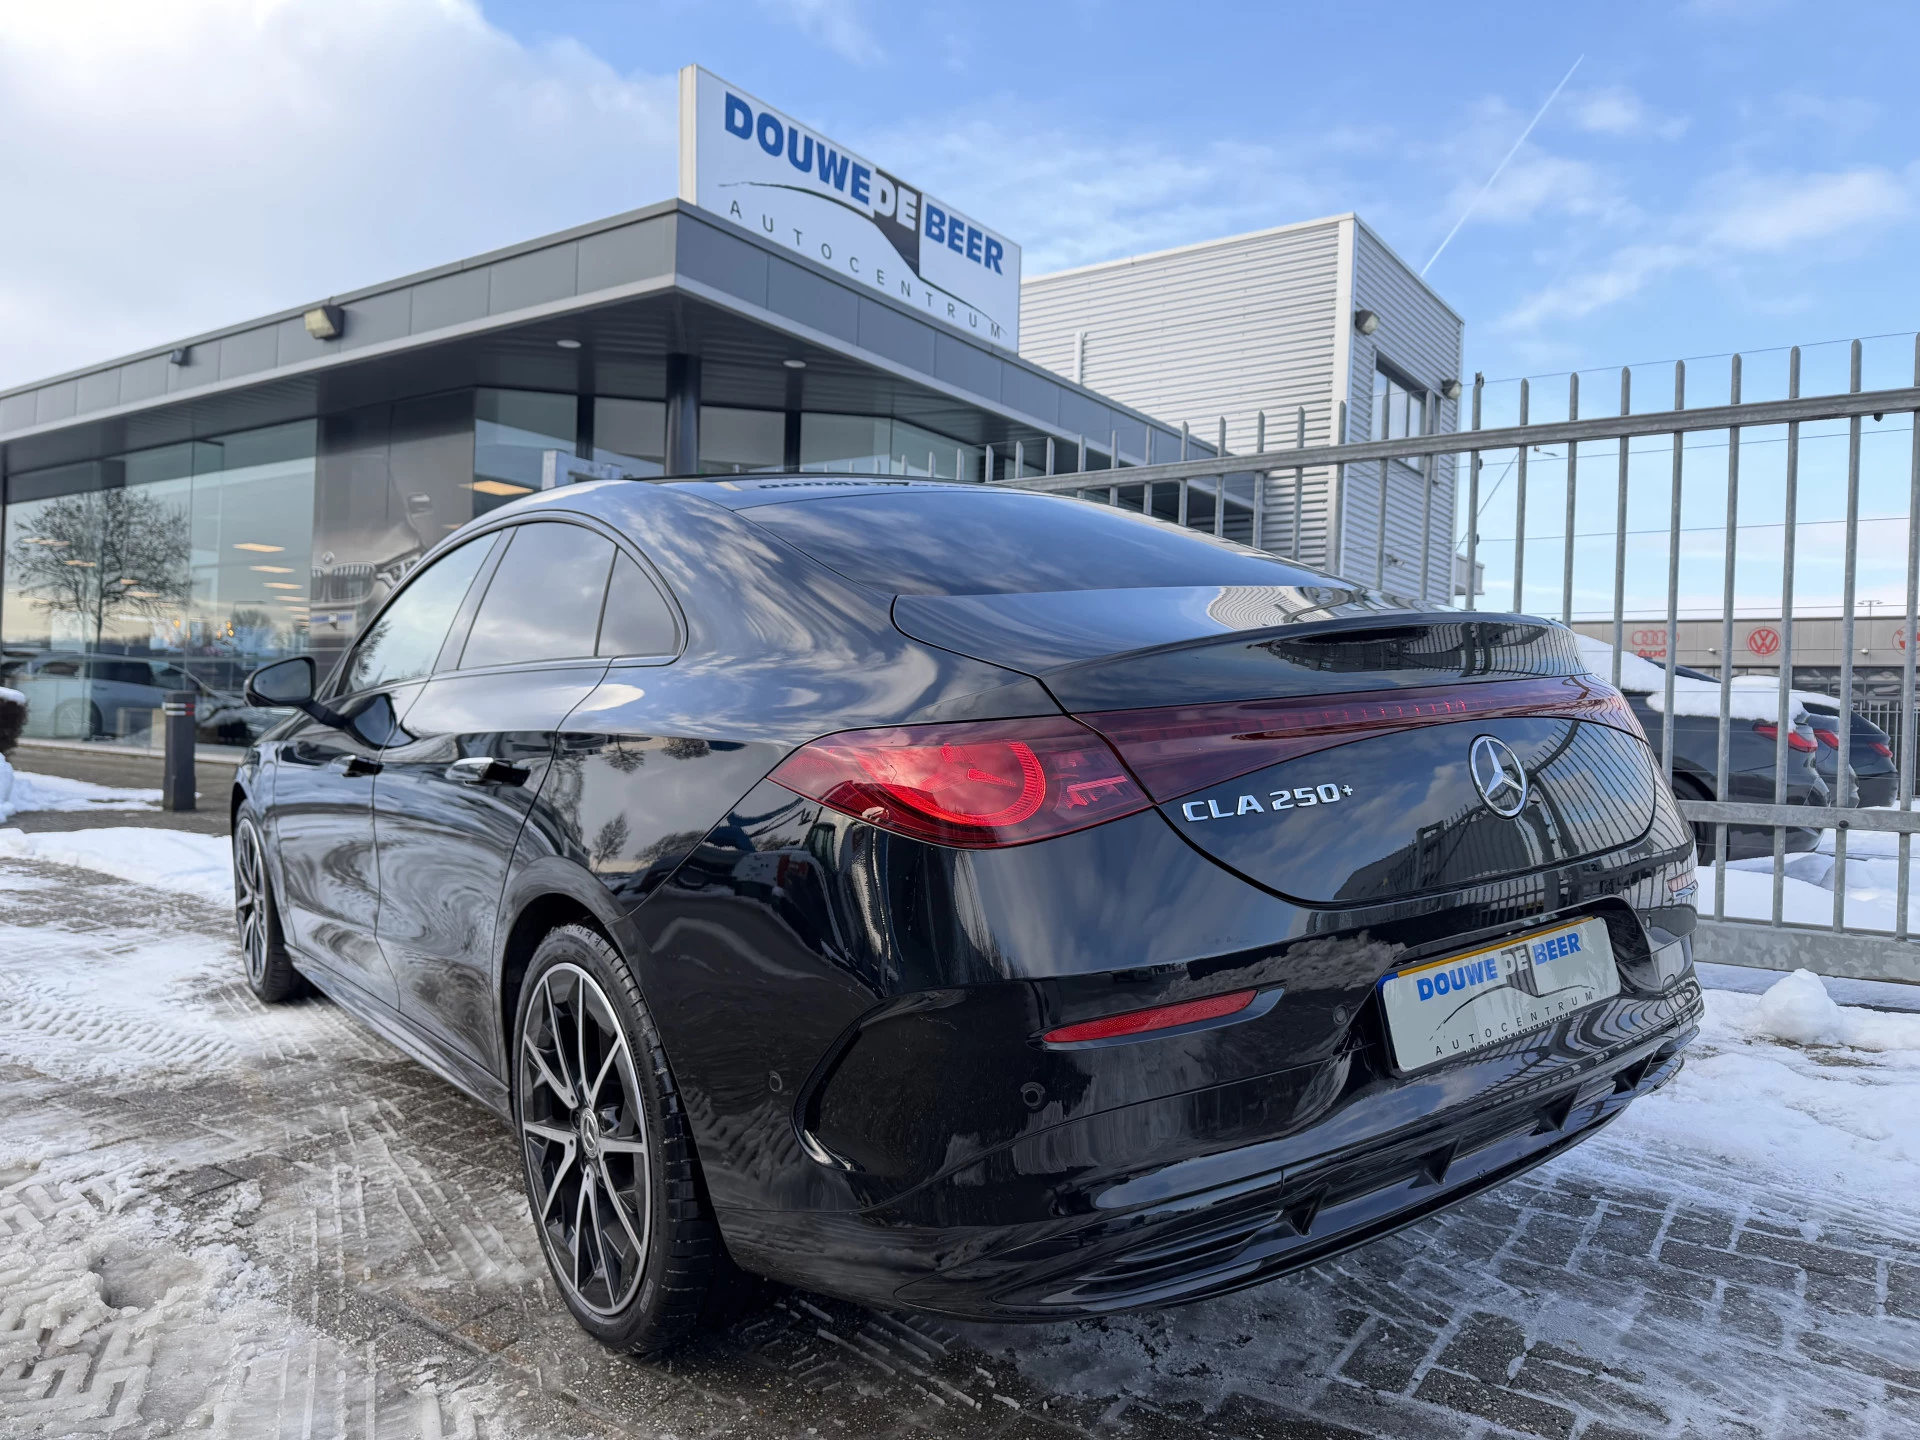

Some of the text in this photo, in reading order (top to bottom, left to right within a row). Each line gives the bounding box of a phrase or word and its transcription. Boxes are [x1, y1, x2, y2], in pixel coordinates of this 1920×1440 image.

[725, 91, 1003, 275] DOUWE DE BEER
[730, 200, 1001, 339] AUTOCENTRUM
[1182, 794, 1265, 822] CLA
[1416, 933, 1581, 1001] DOUWE DE BEER
[1435, 992, 1594, 1056] AUTOCENTRUM
